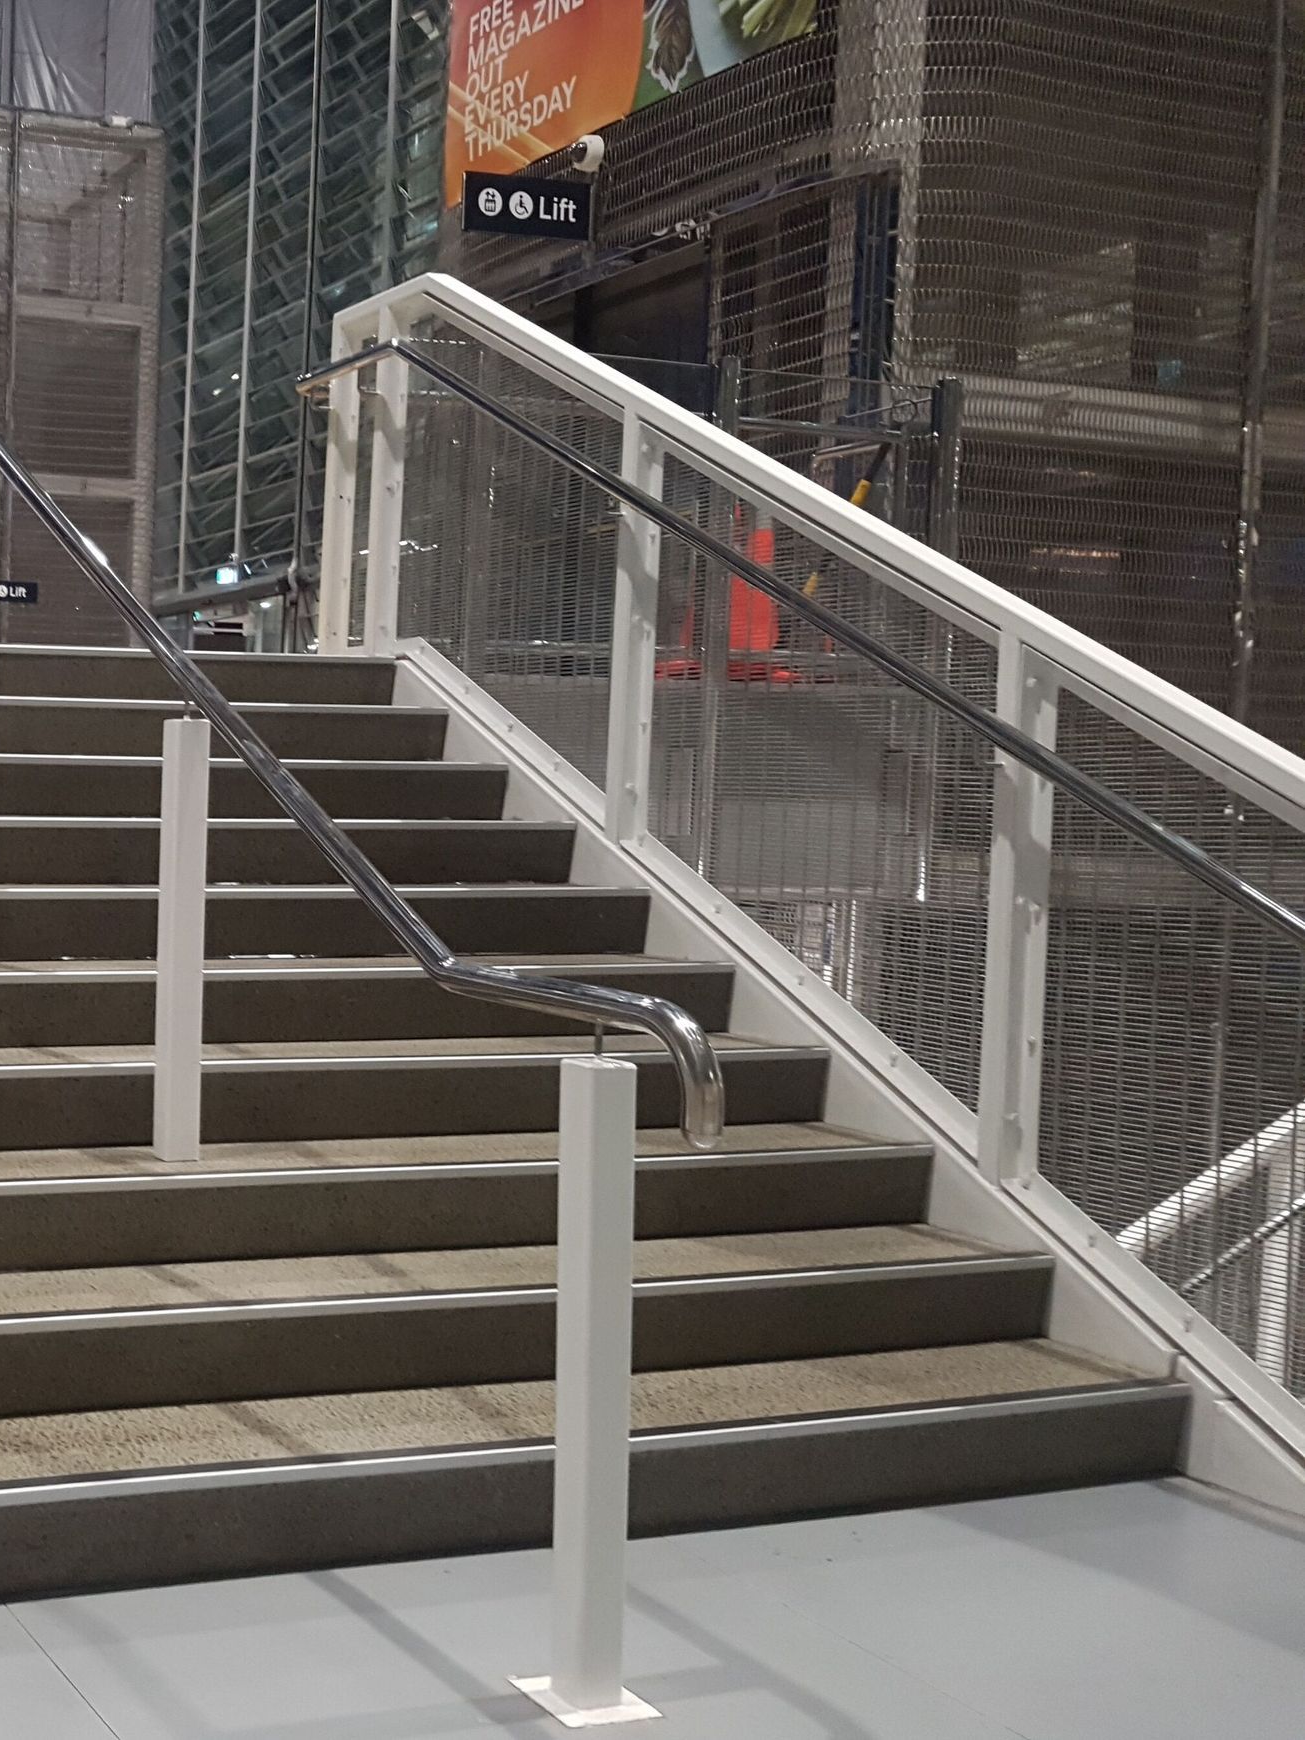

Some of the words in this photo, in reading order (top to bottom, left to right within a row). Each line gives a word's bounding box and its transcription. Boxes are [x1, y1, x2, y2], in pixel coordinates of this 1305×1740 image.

[469, 0, 514, 45] FREE
[466, 53, 508, 99] OUT
[464, 69, 529, 134] EVERY
[464, 75, 577, 162] THURSDAY
[539, 196, 577, 223] Lift
[8, 585, 27, 598] Lift
